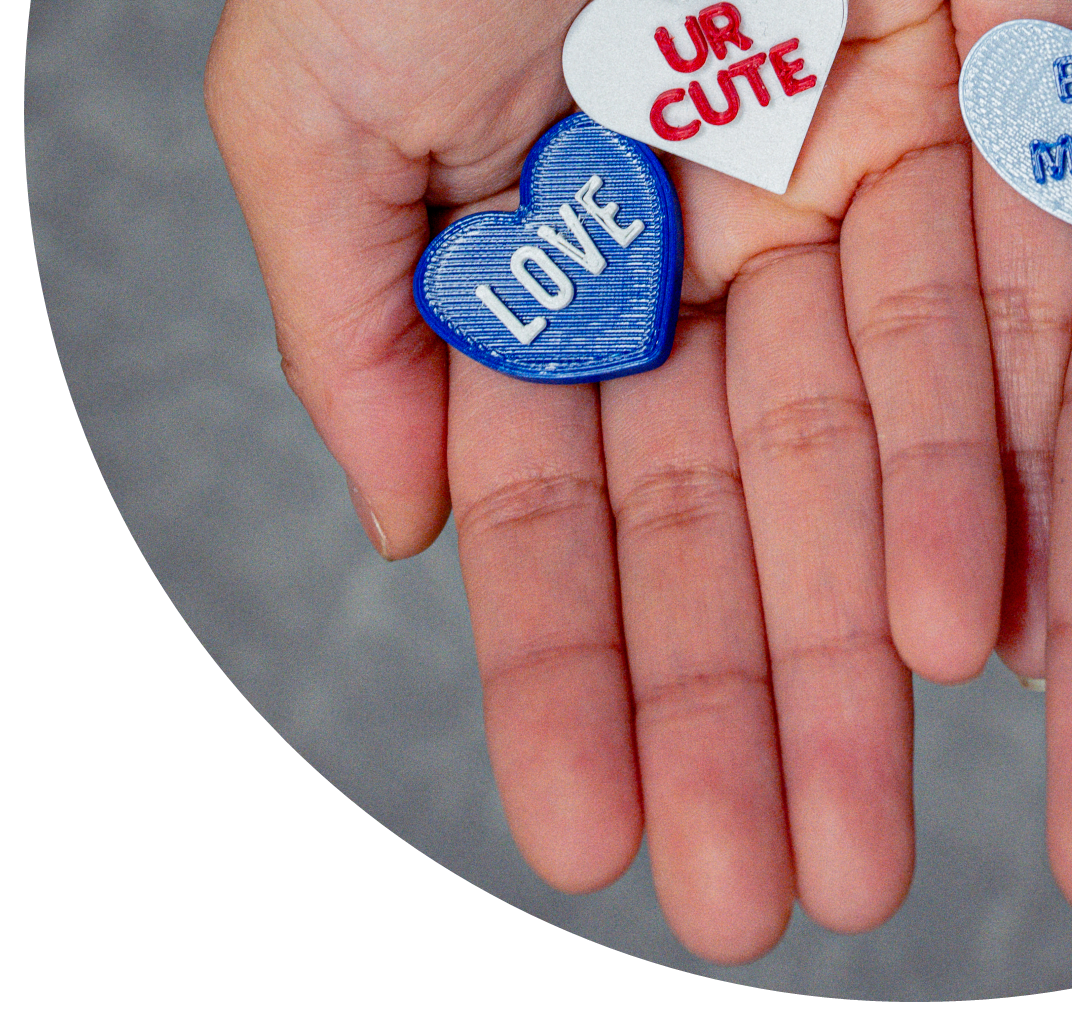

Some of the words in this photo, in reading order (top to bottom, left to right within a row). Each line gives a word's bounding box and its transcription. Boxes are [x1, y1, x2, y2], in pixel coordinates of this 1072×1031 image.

[654, 1, 753, 73] UR
[650, 38, 817, 141] CUTE
[475, 174, 645, 345] LOVE
